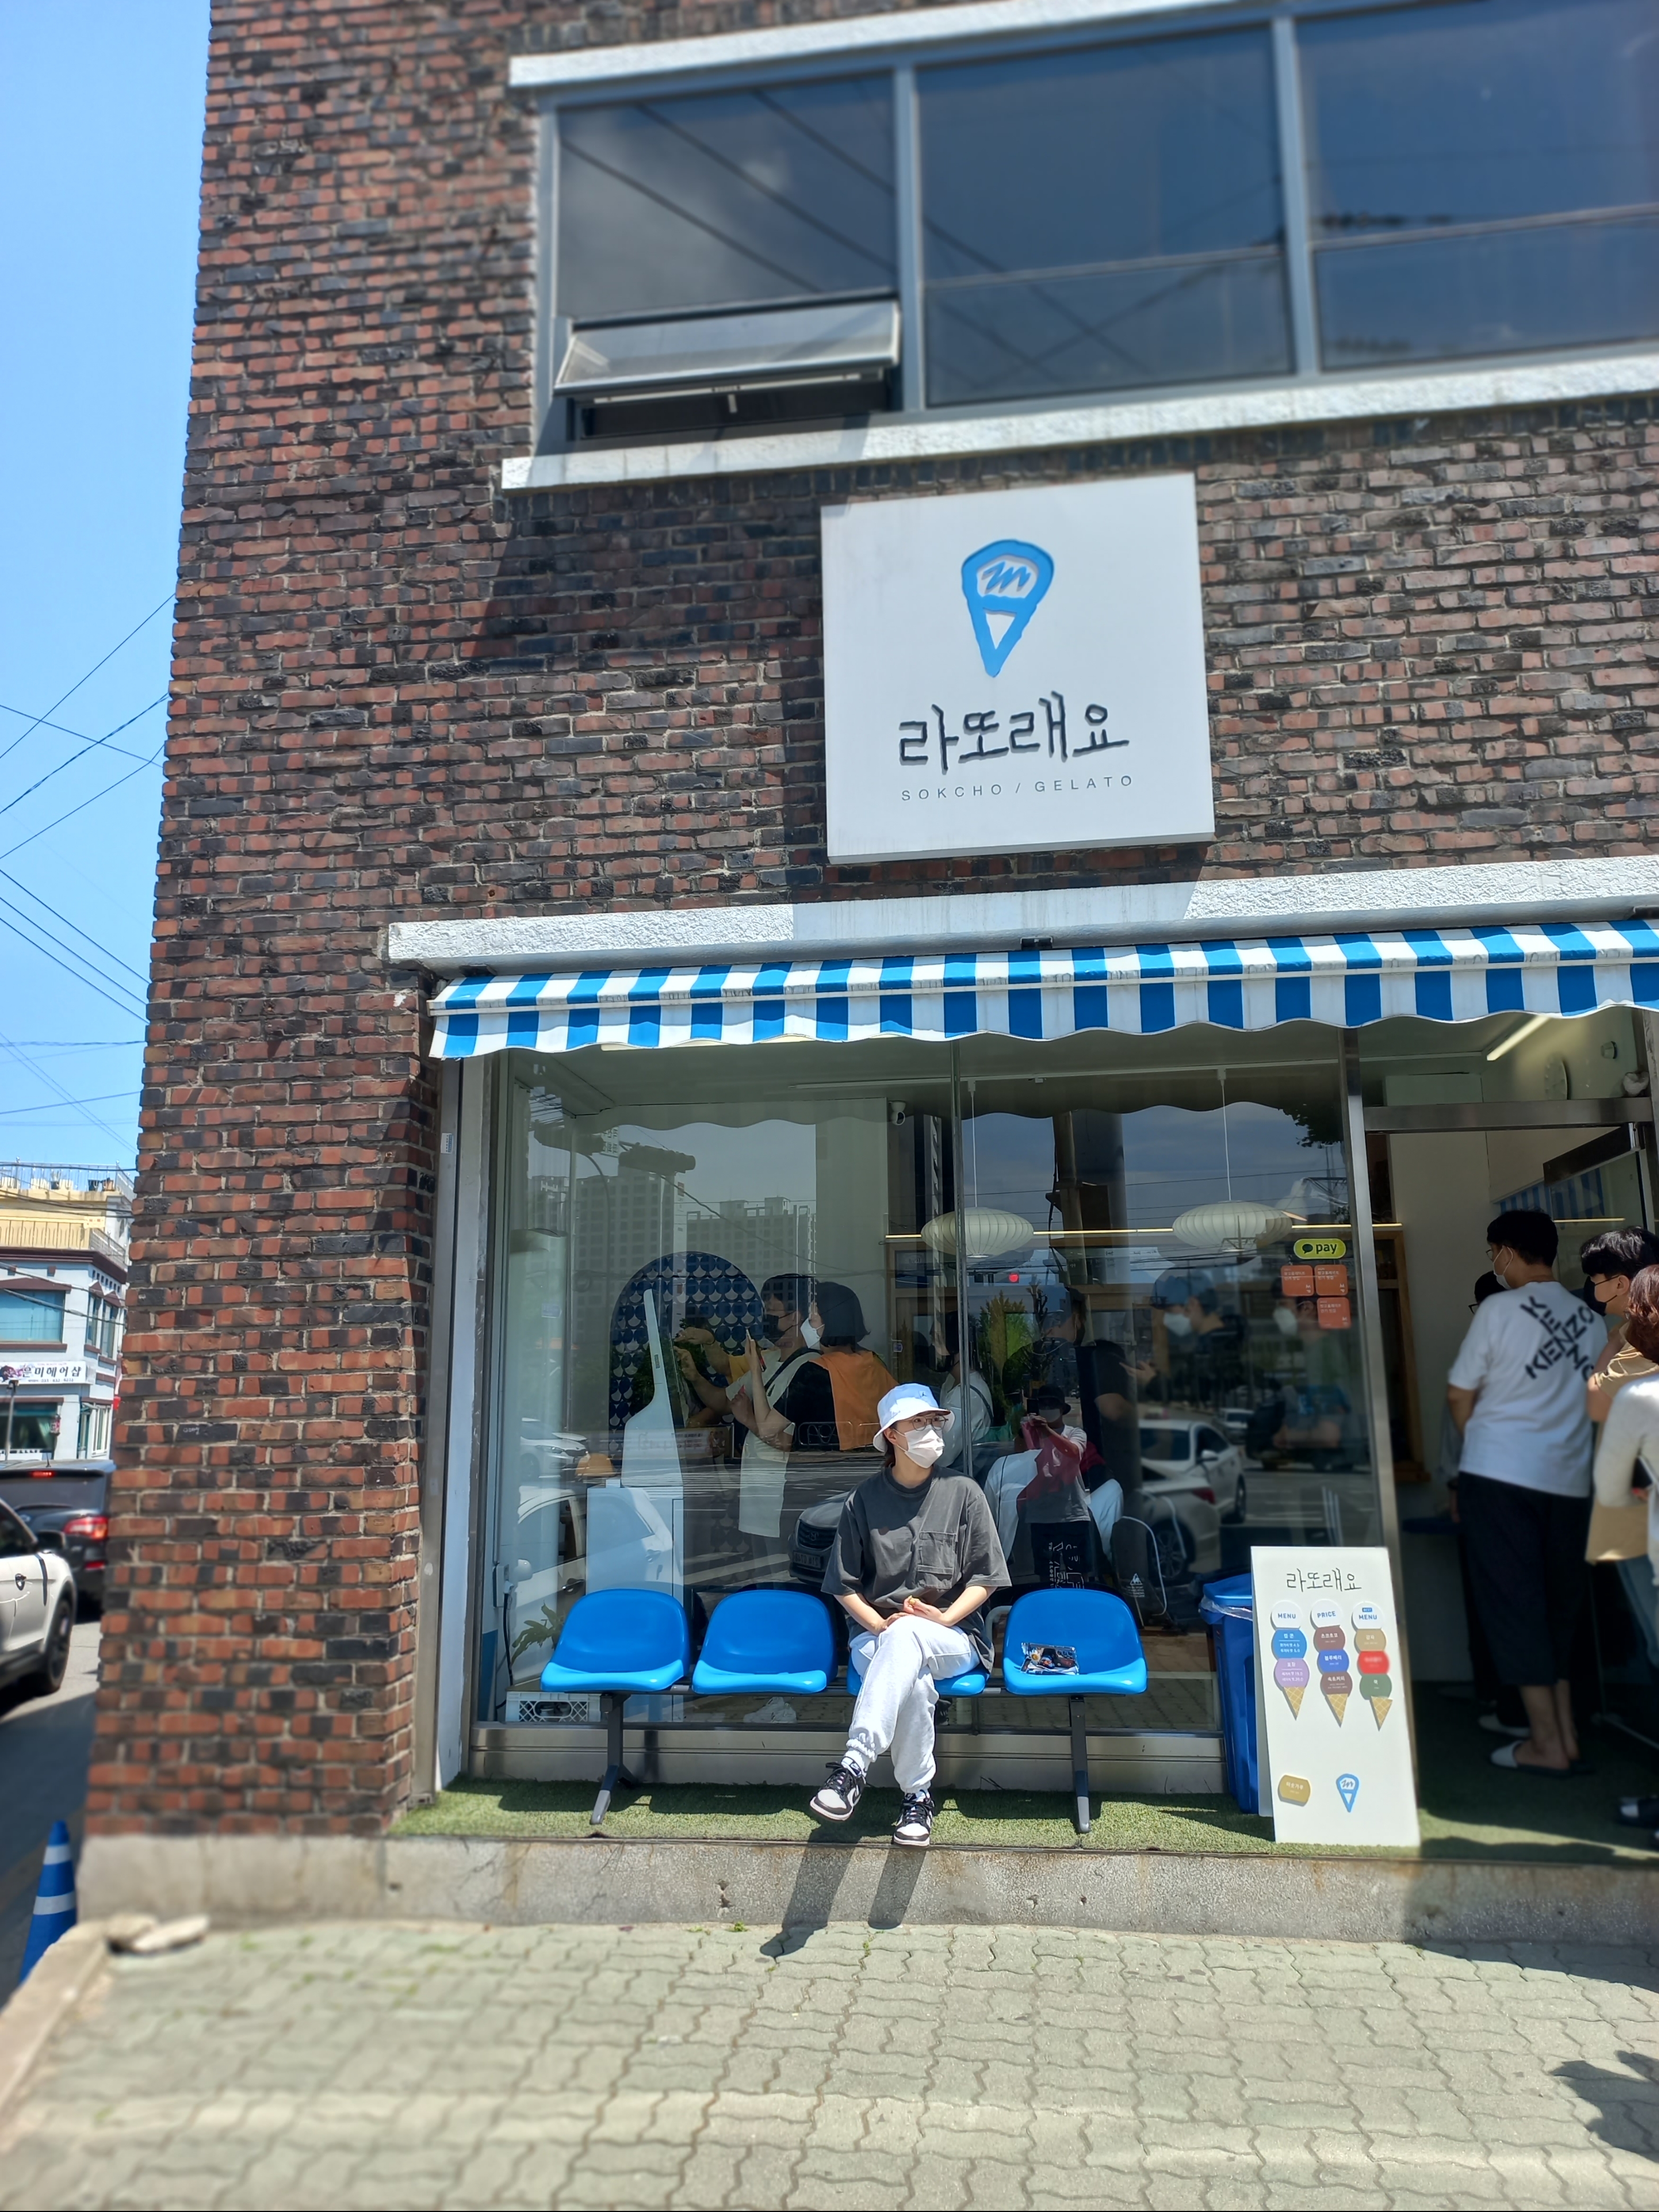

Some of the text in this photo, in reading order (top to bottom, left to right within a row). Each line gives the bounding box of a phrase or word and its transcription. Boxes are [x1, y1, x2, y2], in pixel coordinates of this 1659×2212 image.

[899, 690, 1130, 773] 라또래요
[901, 784, 1002, 801] SOKCHO
[1034, 775, 1132, 793] GELATO
[1316, 1243, 1337, 1254] pay
[1525, 1305, 1594, 1380] KENZO
[1287, 1568, 1362, 1592] 라또래요
